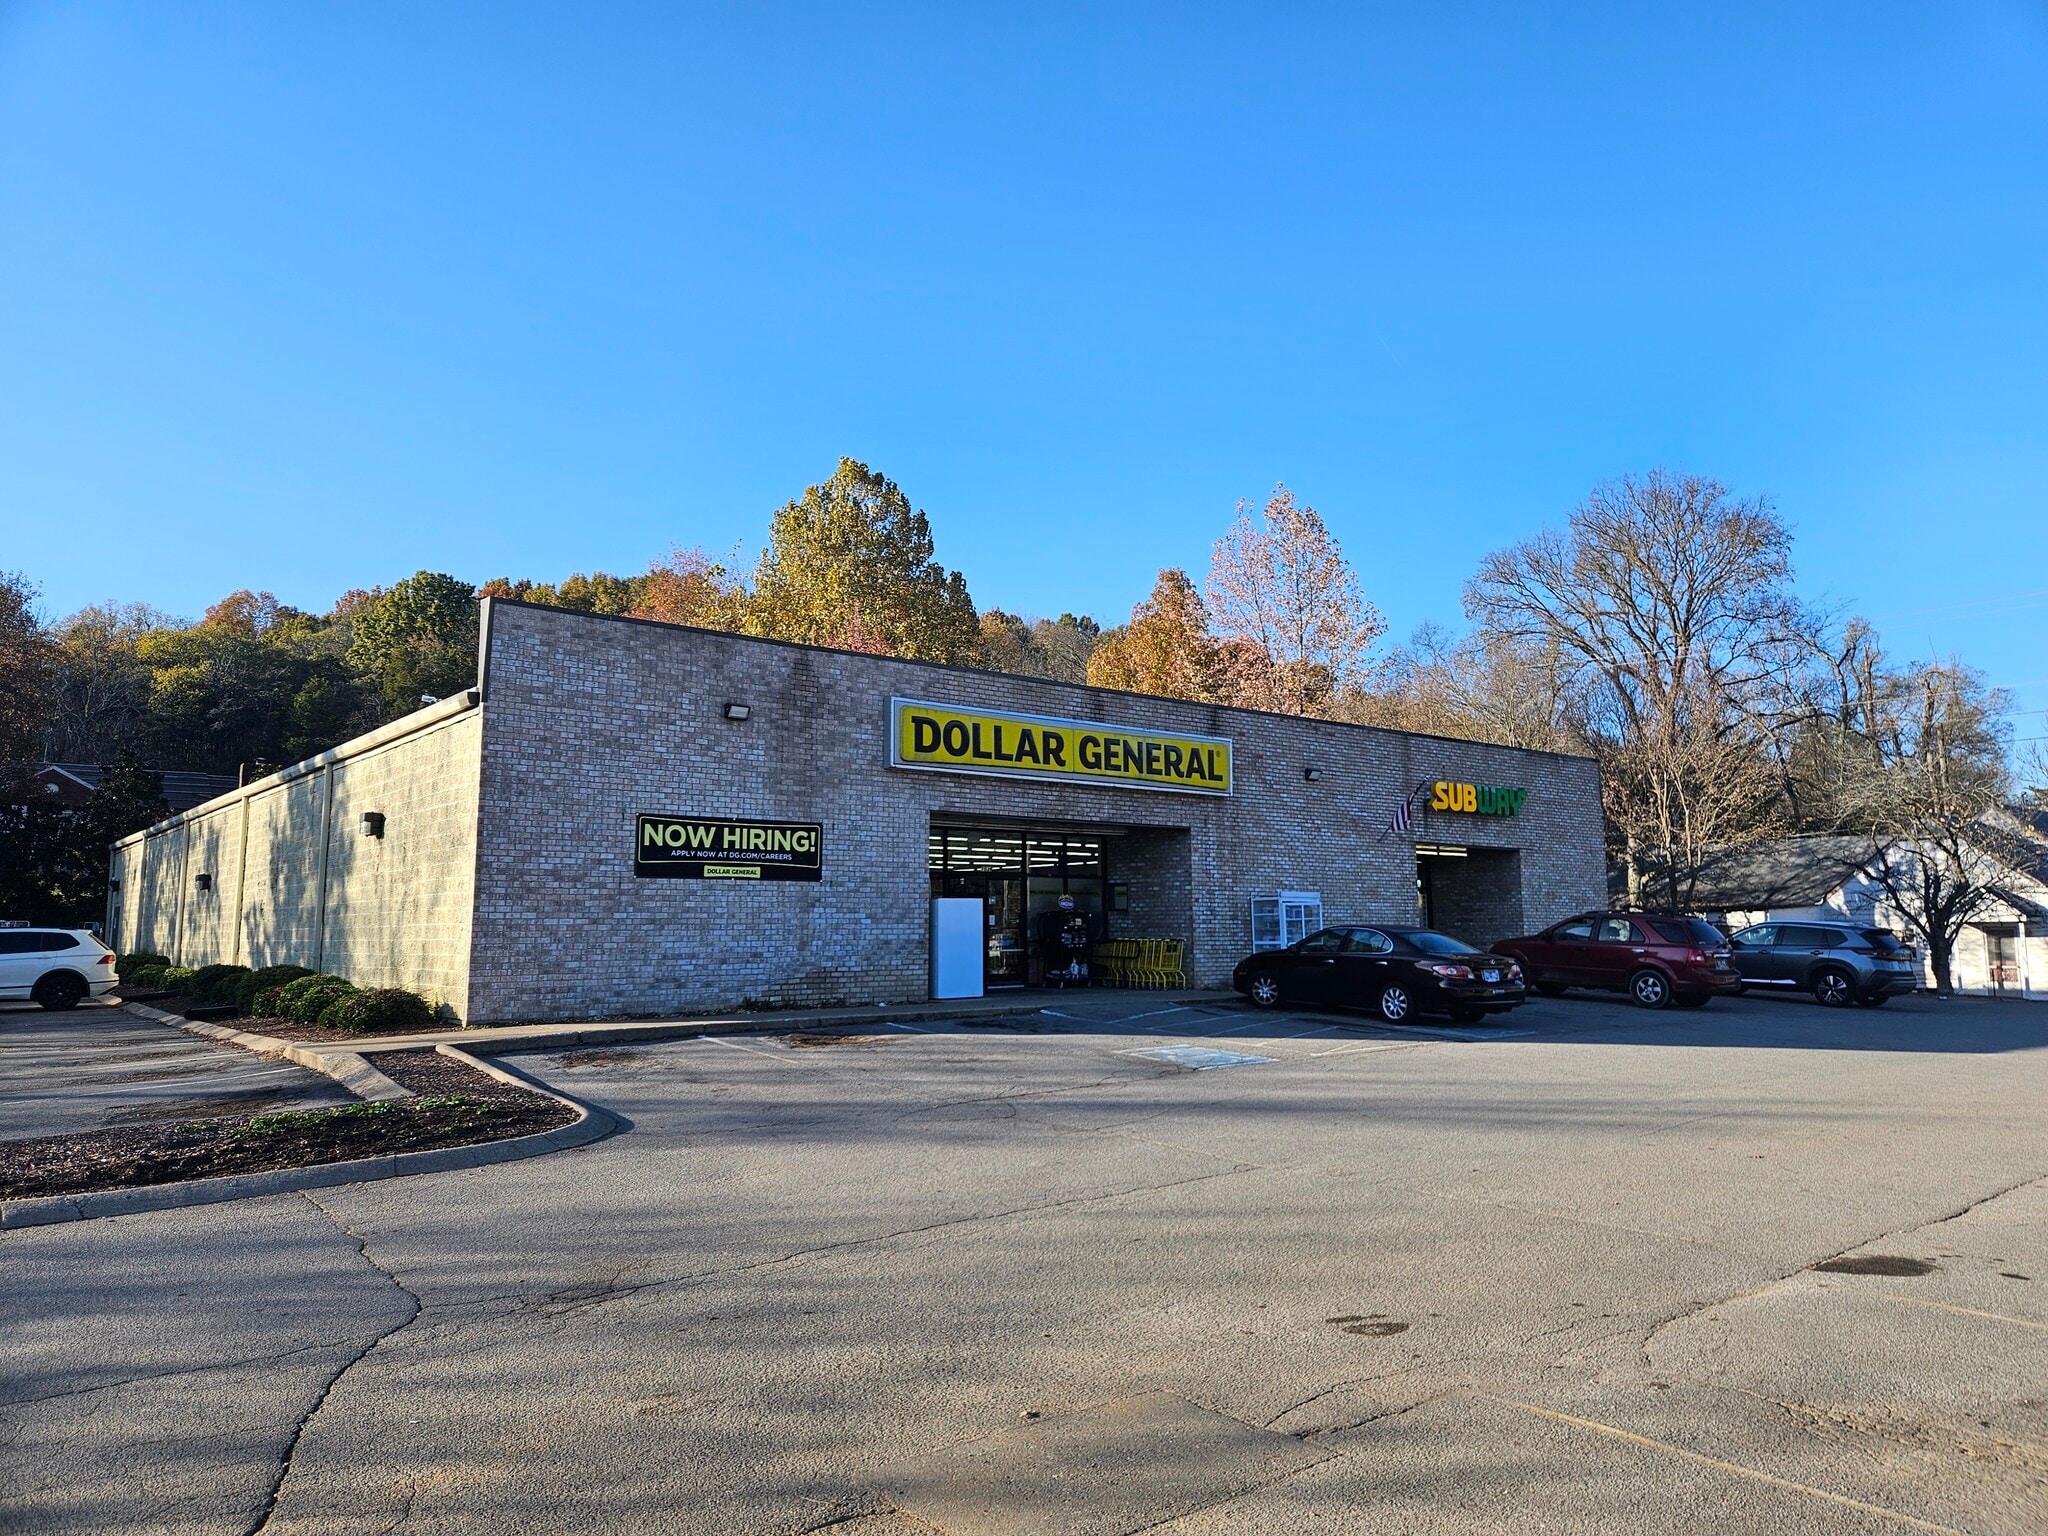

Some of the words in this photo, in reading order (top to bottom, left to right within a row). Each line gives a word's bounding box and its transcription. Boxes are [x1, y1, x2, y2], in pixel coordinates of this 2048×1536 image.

[911, 715, 1066, 767] DOLLAR
[1078, 735, 1224, 782] GENERAL
[1431, 781, 1527, 816] SUBWAY
[643, 823, 716, 848] NOW
[723, 827, 816, 852] HIRING!
[729, 852, 792, 860] DG.COM/CAREERS
